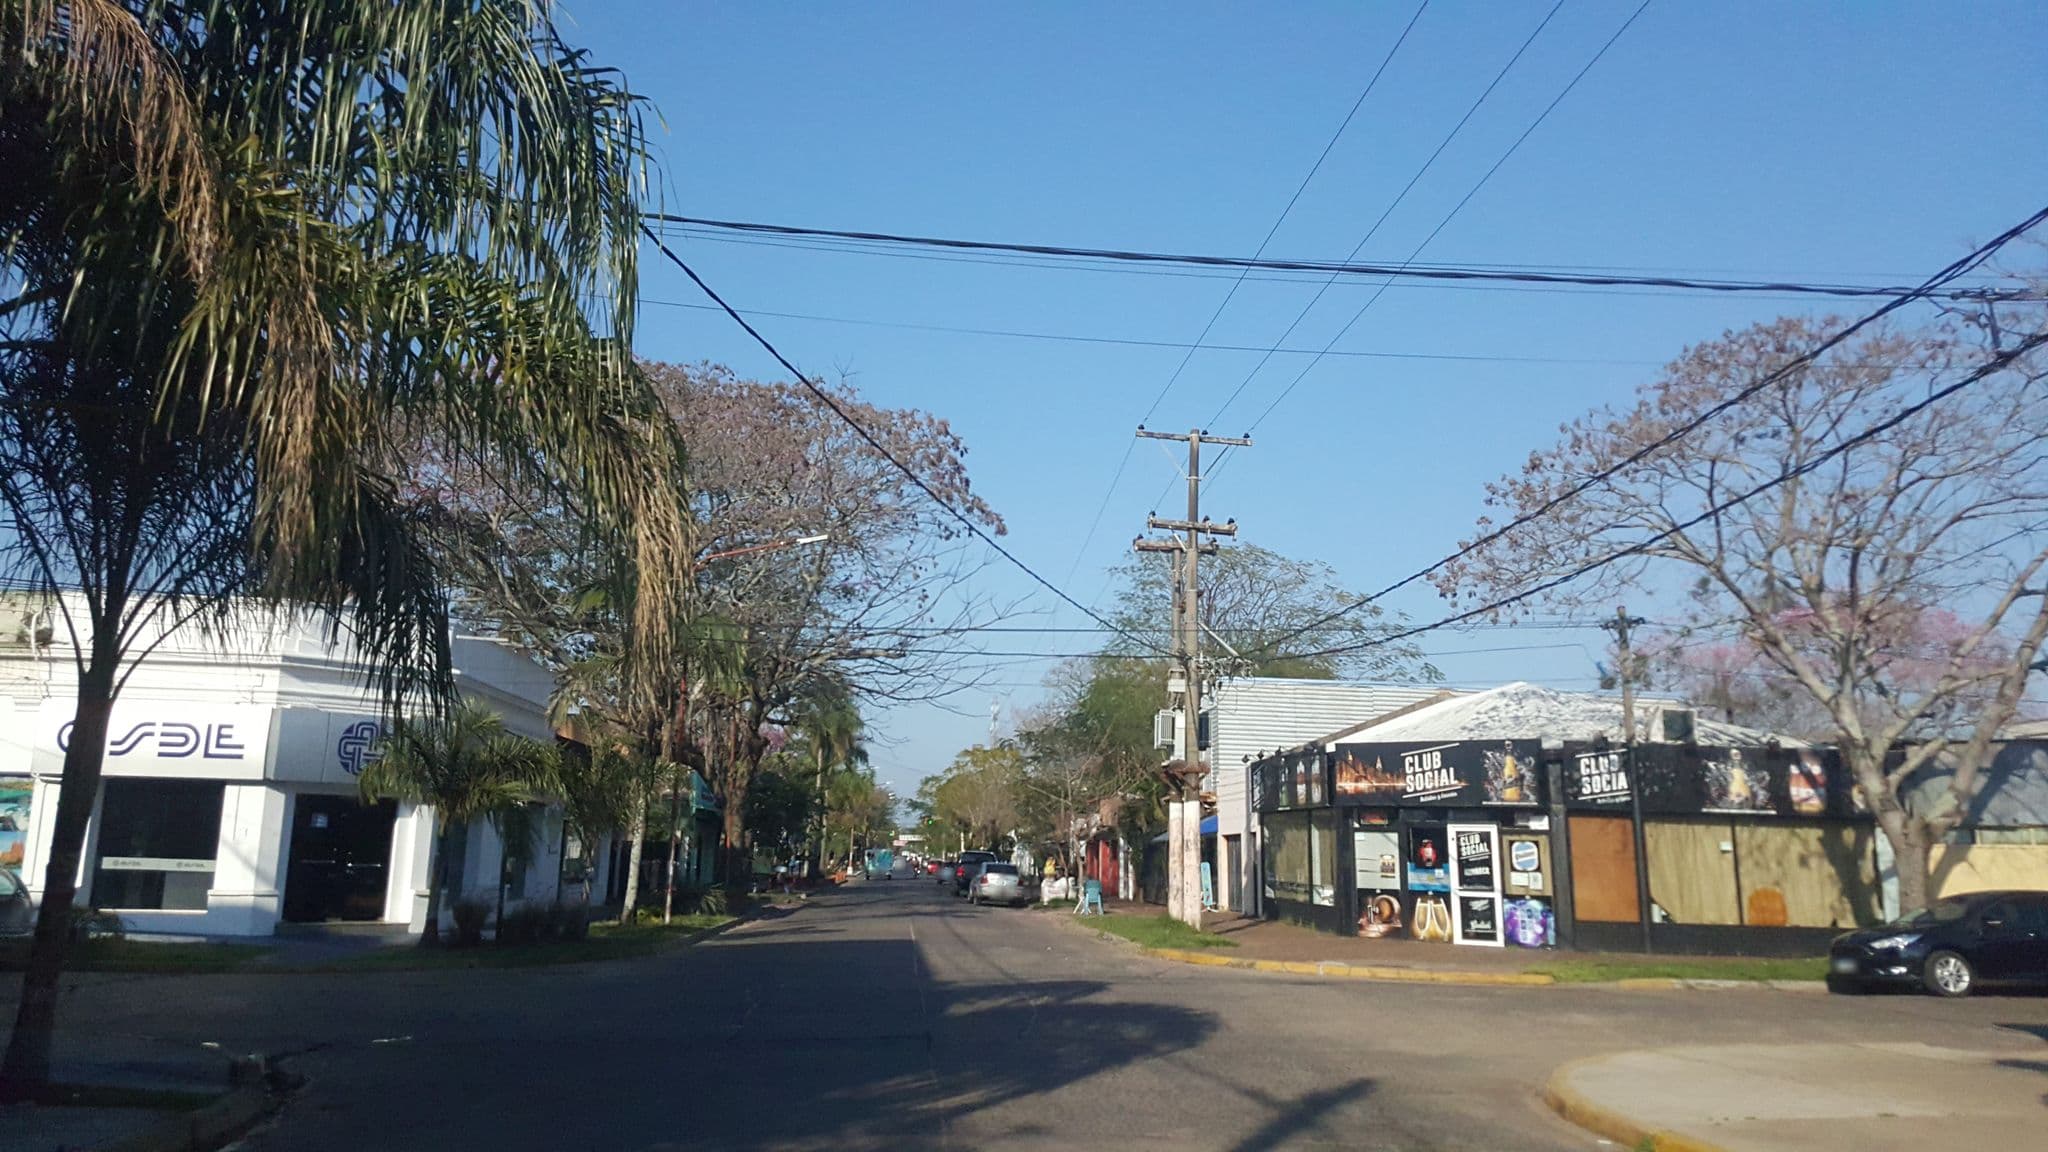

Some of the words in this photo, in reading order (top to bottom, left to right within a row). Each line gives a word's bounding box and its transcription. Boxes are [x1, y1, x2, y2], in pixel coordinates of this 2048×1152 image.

[1405, 751, 1442, 774] CLUB
[1580, 754, 1619, 776] CLUB
[1406, 767, 1459, 793] SOCIAL
[1581, 771, 1629, 795] SOCIA
[1460, 834, 1481, 847] CLUB
[1461, 842, 1489, 857] SOCIAL
